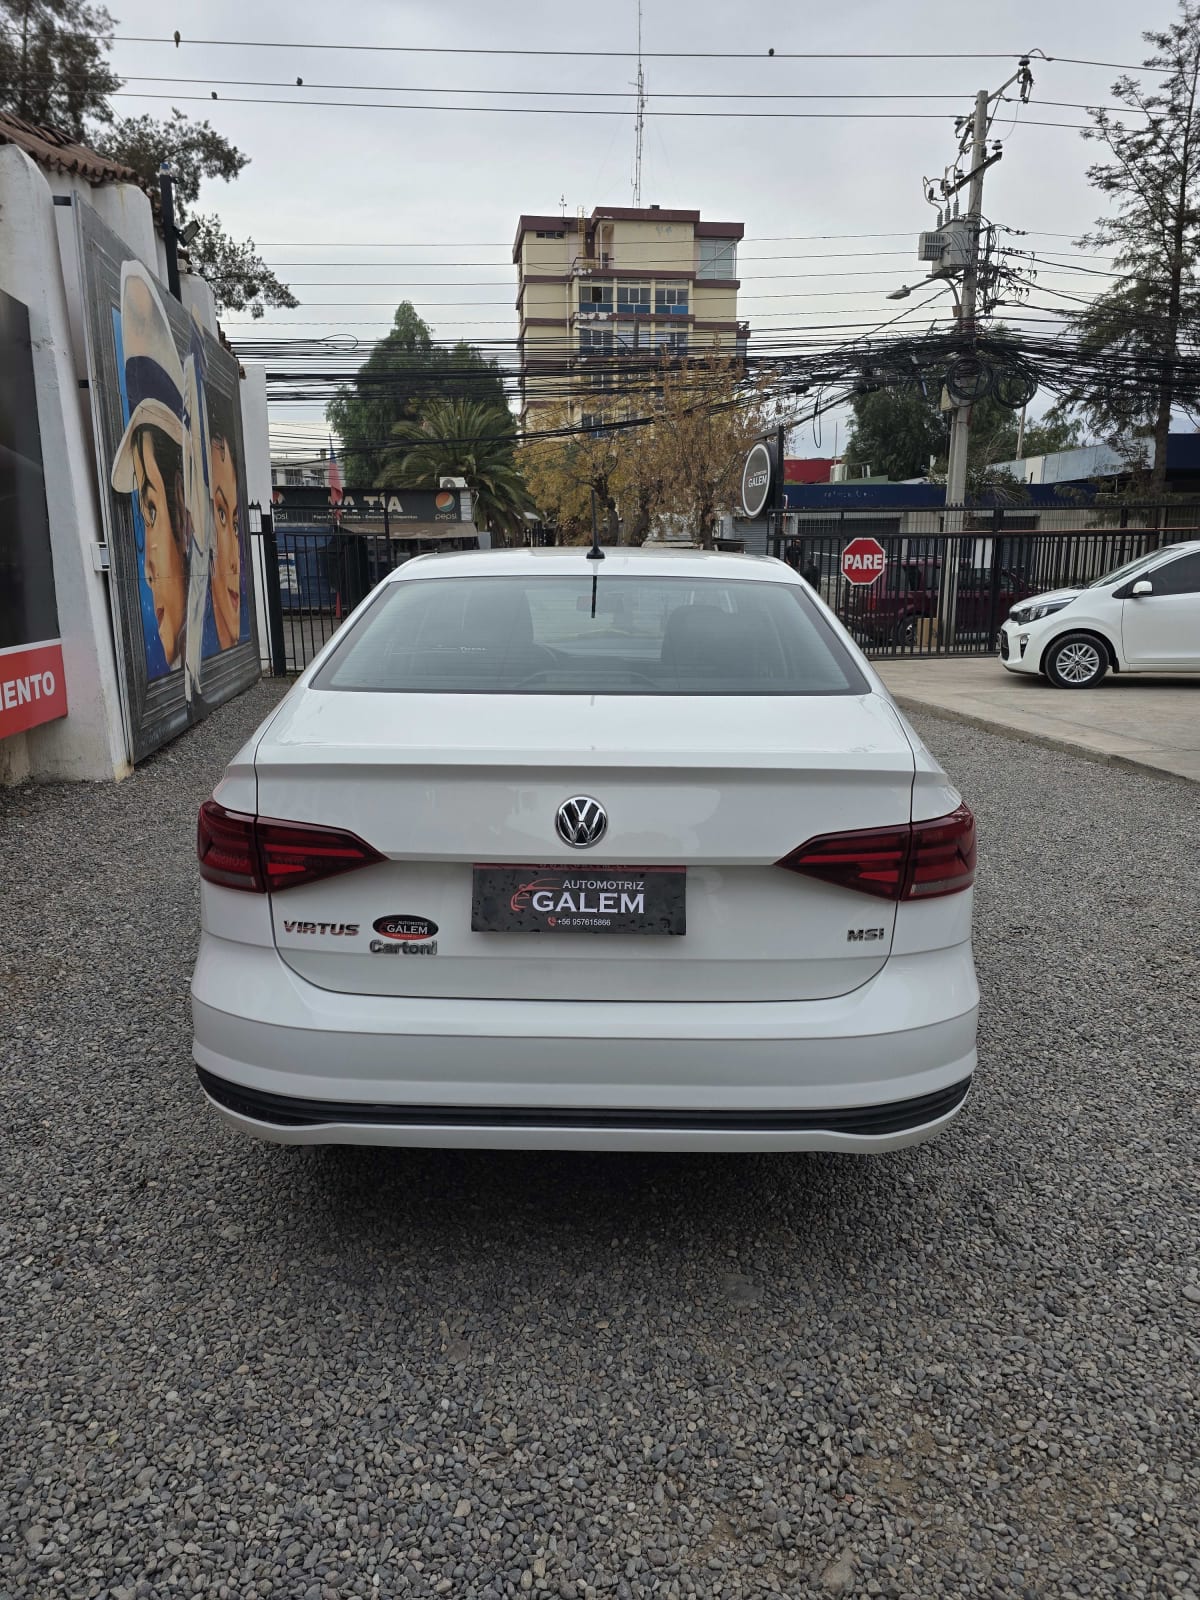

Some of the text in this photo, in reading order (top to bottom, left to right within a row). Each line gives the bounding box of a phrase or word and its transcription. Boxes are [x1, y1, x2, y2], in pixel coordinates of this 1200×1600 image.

[748, 475, 767, 488] GALEM
[435, 513, 457, 521] pepsi
[844, 554, 883, 570] PARE
[562, 879, 645, 890] AUTOMOTRIZ
[532, 891, 645, 914] GALEM
[283, 920, 361, 936] VIRTUS
[557, 918, 571, 926] +56
[386, 924, 428, 935] GALEM
